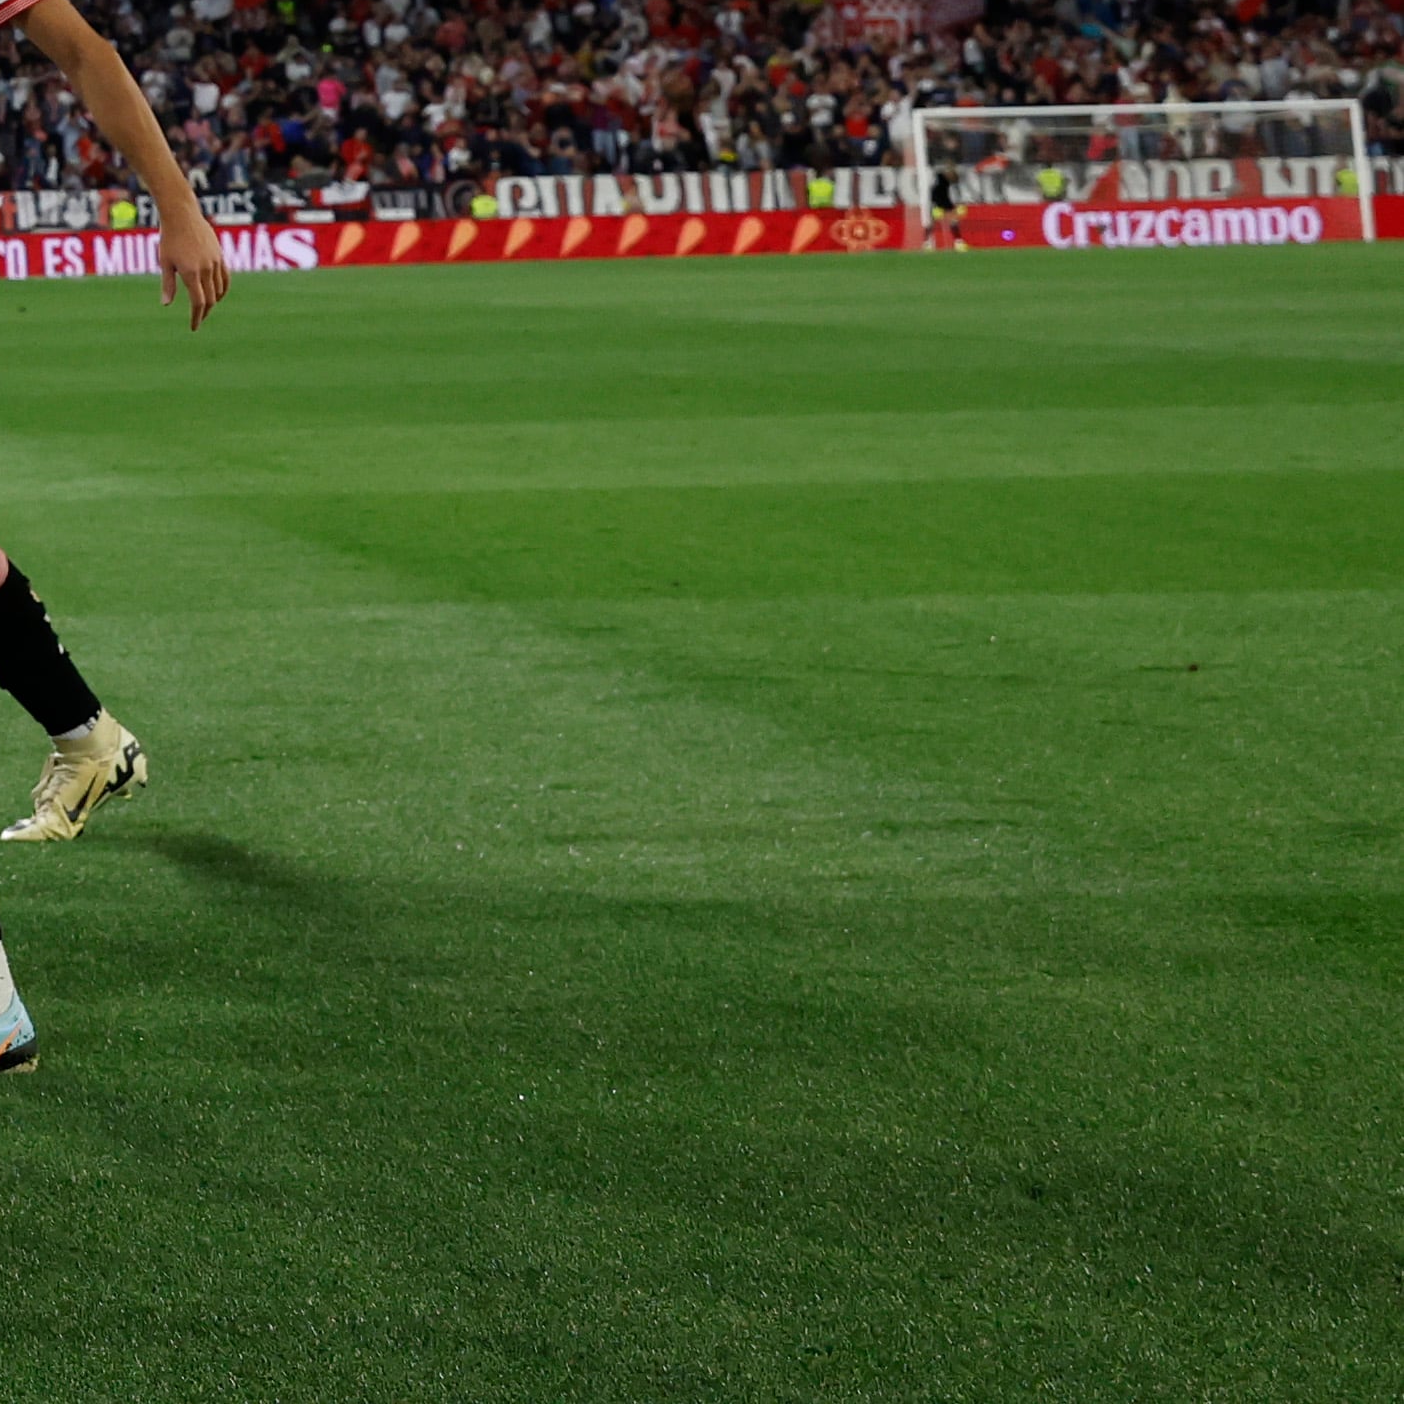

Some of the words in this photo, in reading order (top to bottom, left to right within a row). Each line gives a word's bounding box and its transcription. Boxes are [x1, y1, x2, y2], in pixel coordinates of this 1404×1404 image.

[42, 235, 85, 277] ES
[91, 228, 161, 275] MUC
[220, 223, 319, 272] MÁS
[1042, 200, 1323, 249] Cruzcampo
